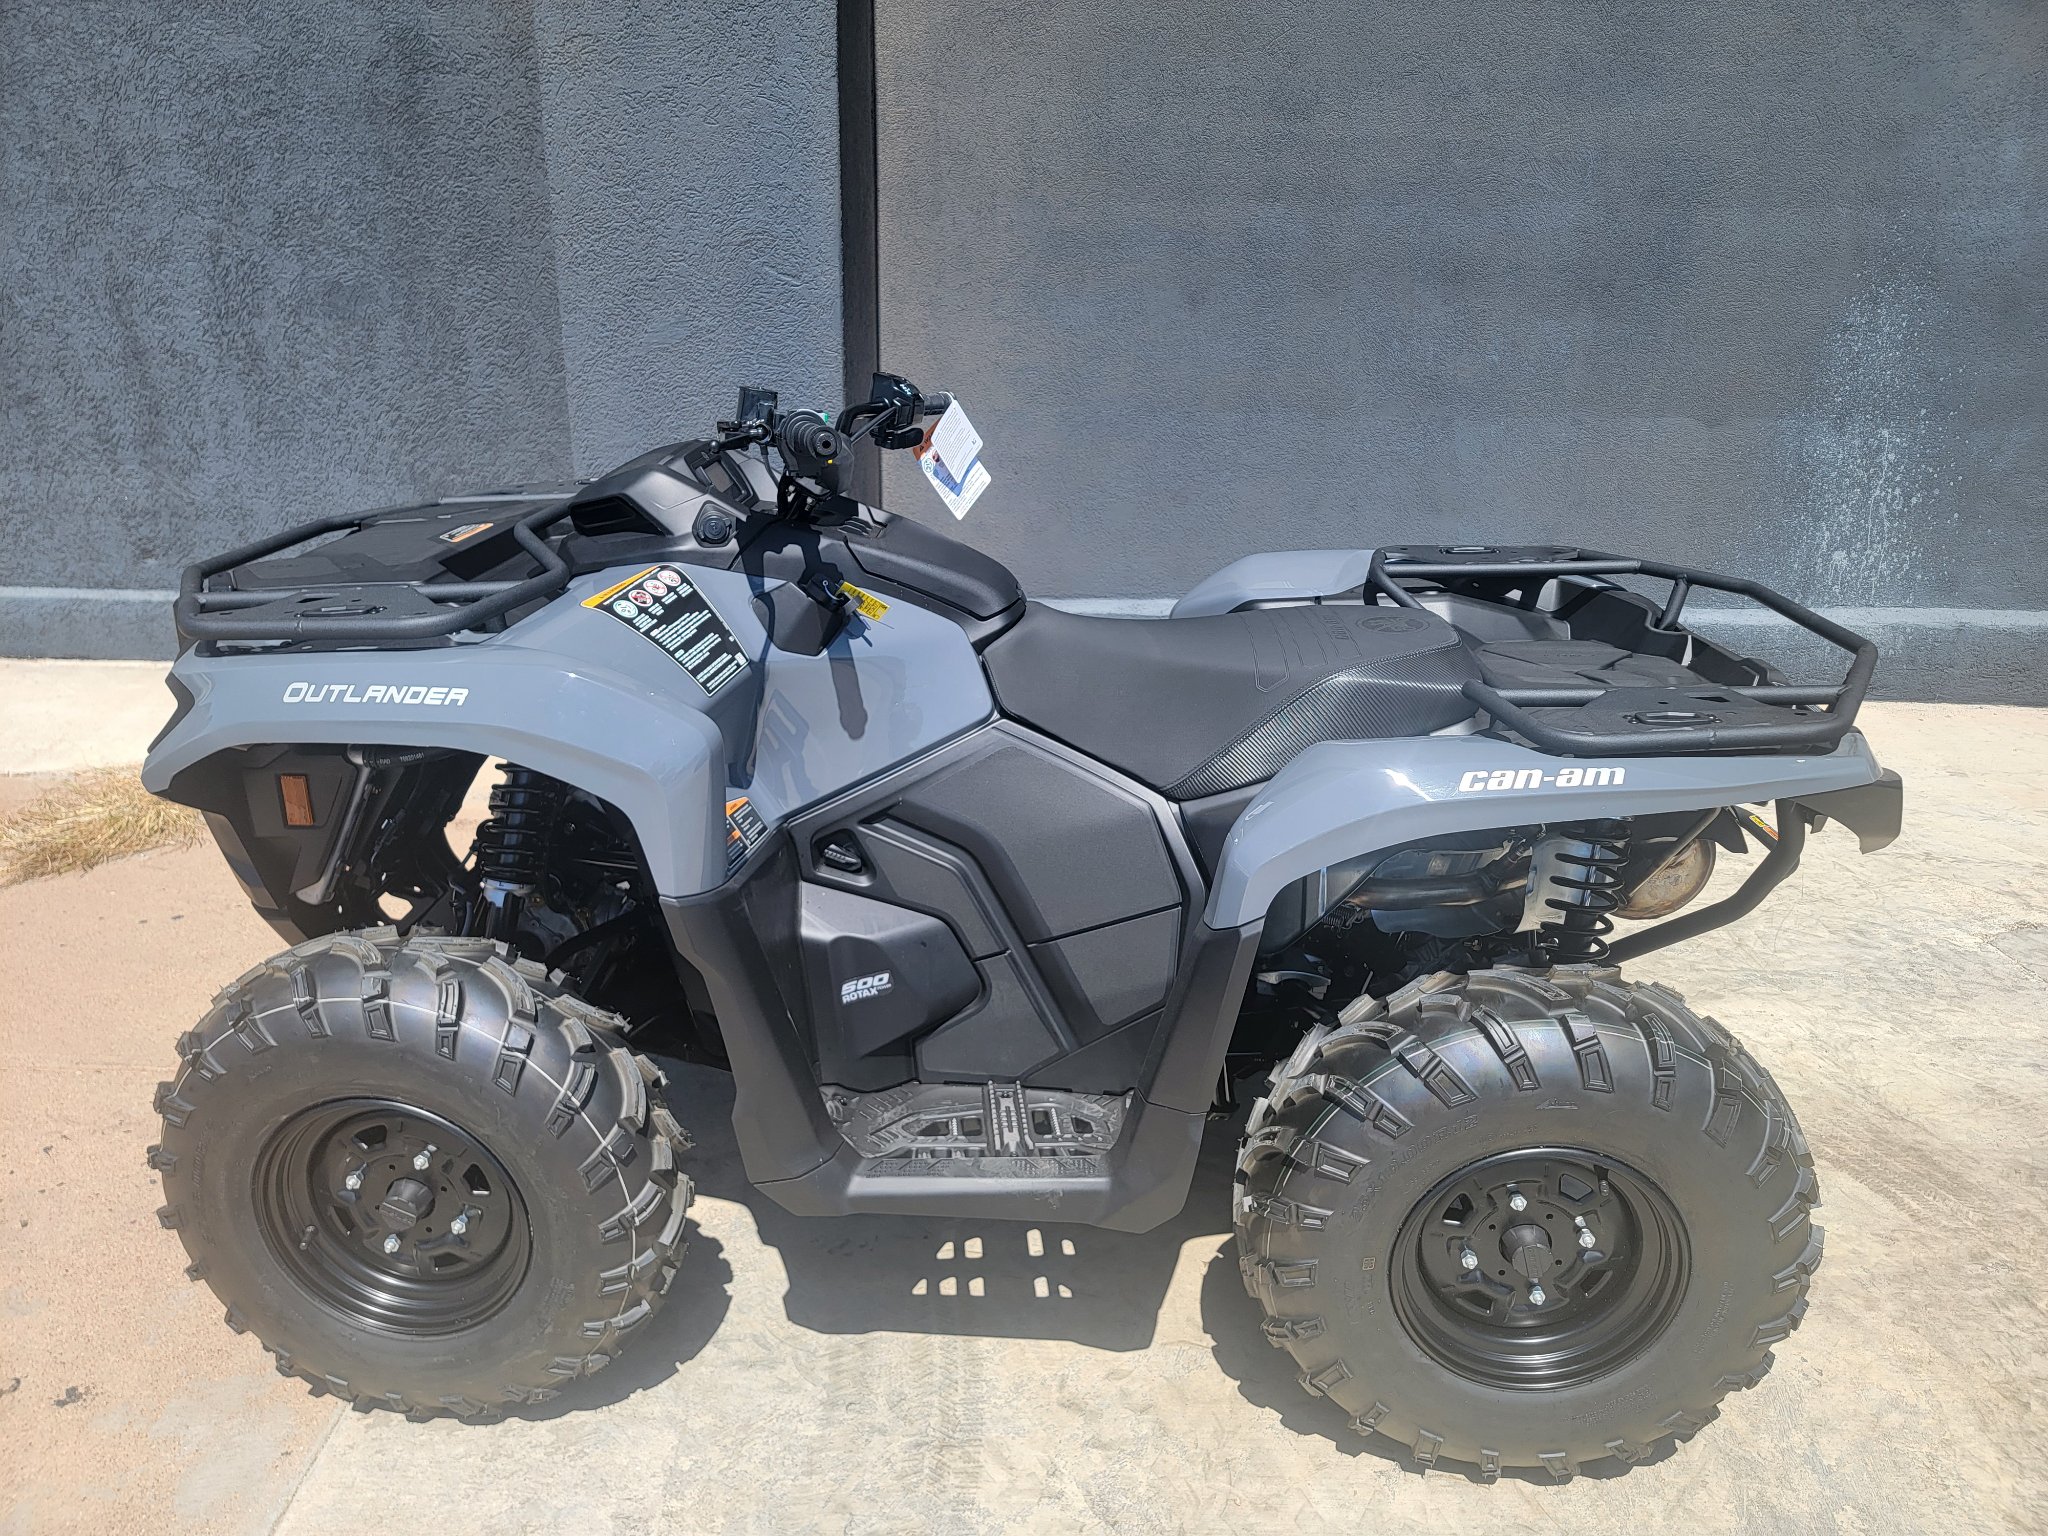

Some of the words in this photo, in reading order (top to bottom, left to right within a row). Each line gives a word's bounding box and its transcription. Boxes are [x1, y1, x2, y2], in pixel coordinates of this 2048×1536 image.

[282, 682, 470, 706] OUTLANDER
[1457, 767, 1627, 792] can-am
[841, 972, 890, 995] 500
[842, 986, 879, 1005] ROTAX
